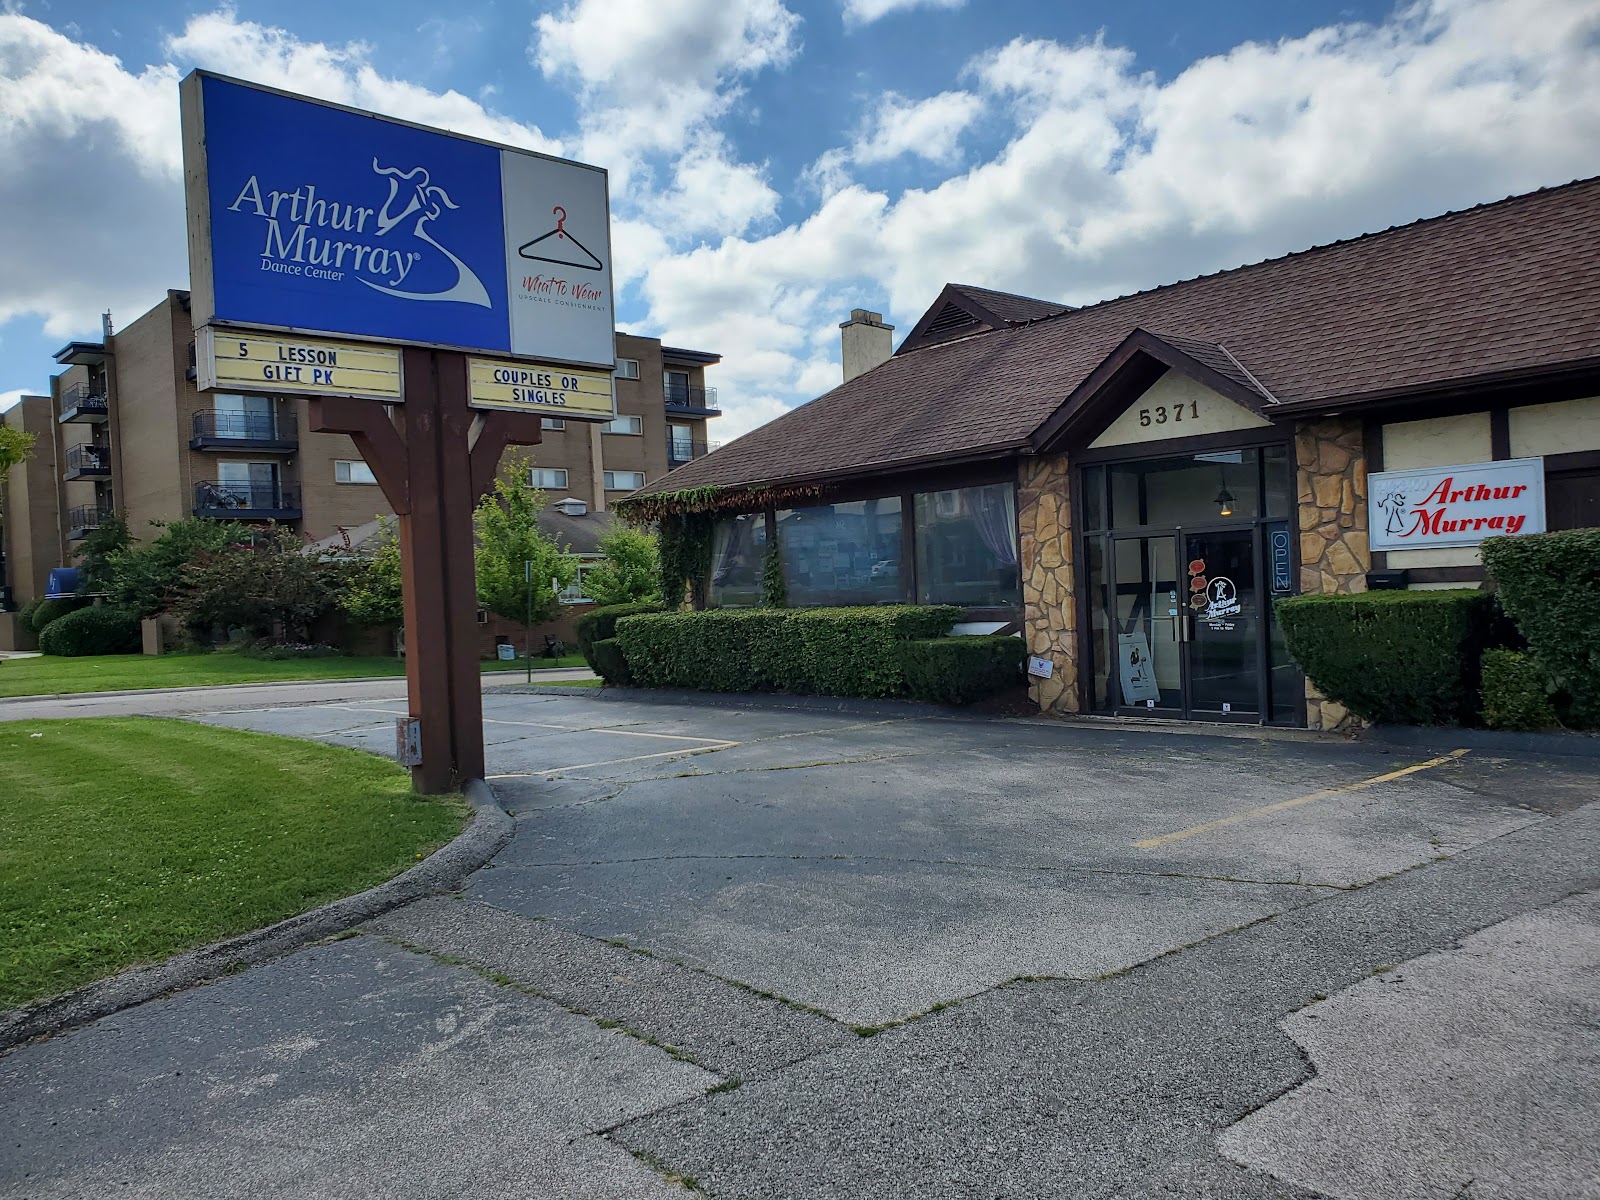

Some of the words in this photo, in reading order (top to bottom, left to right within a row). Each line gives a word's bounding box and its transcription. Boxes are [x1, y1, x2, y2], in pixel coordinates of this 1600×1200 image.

[227, 175, 374, 233] Arthur
[260, 258, 301, 275] Dance
[304, 265, 346, 281] Center
[522, 274, 557, 294] What
[554, 280, 567, 296] To
[571, 282, 602, 300] Wear
[518, 294, 551, 304] UPSCALE
[555, 300, 605, 311] CONSIGNMENT
[239, 342, 248, 357] 5
[278, 346, 337, 365] LESSON
[263, 365, 302, 382] GIFT
[313, 368, 333, 385] PK
[494, 369, 551, 387] COUPLES
[561, 376, 579, 390] OR
[512, 388, 566, 405] SINGLES
[1139, 399, 1200, 427] 5371
[1413, 477, 1527, 506] Arthur
[1397, 507, 1526, 538] Murray
[1274, 534, 1288, 589] OPEN
[1204, 597, 1237, 612] Arthur
[1205, 604, 1241, 620] Murray
